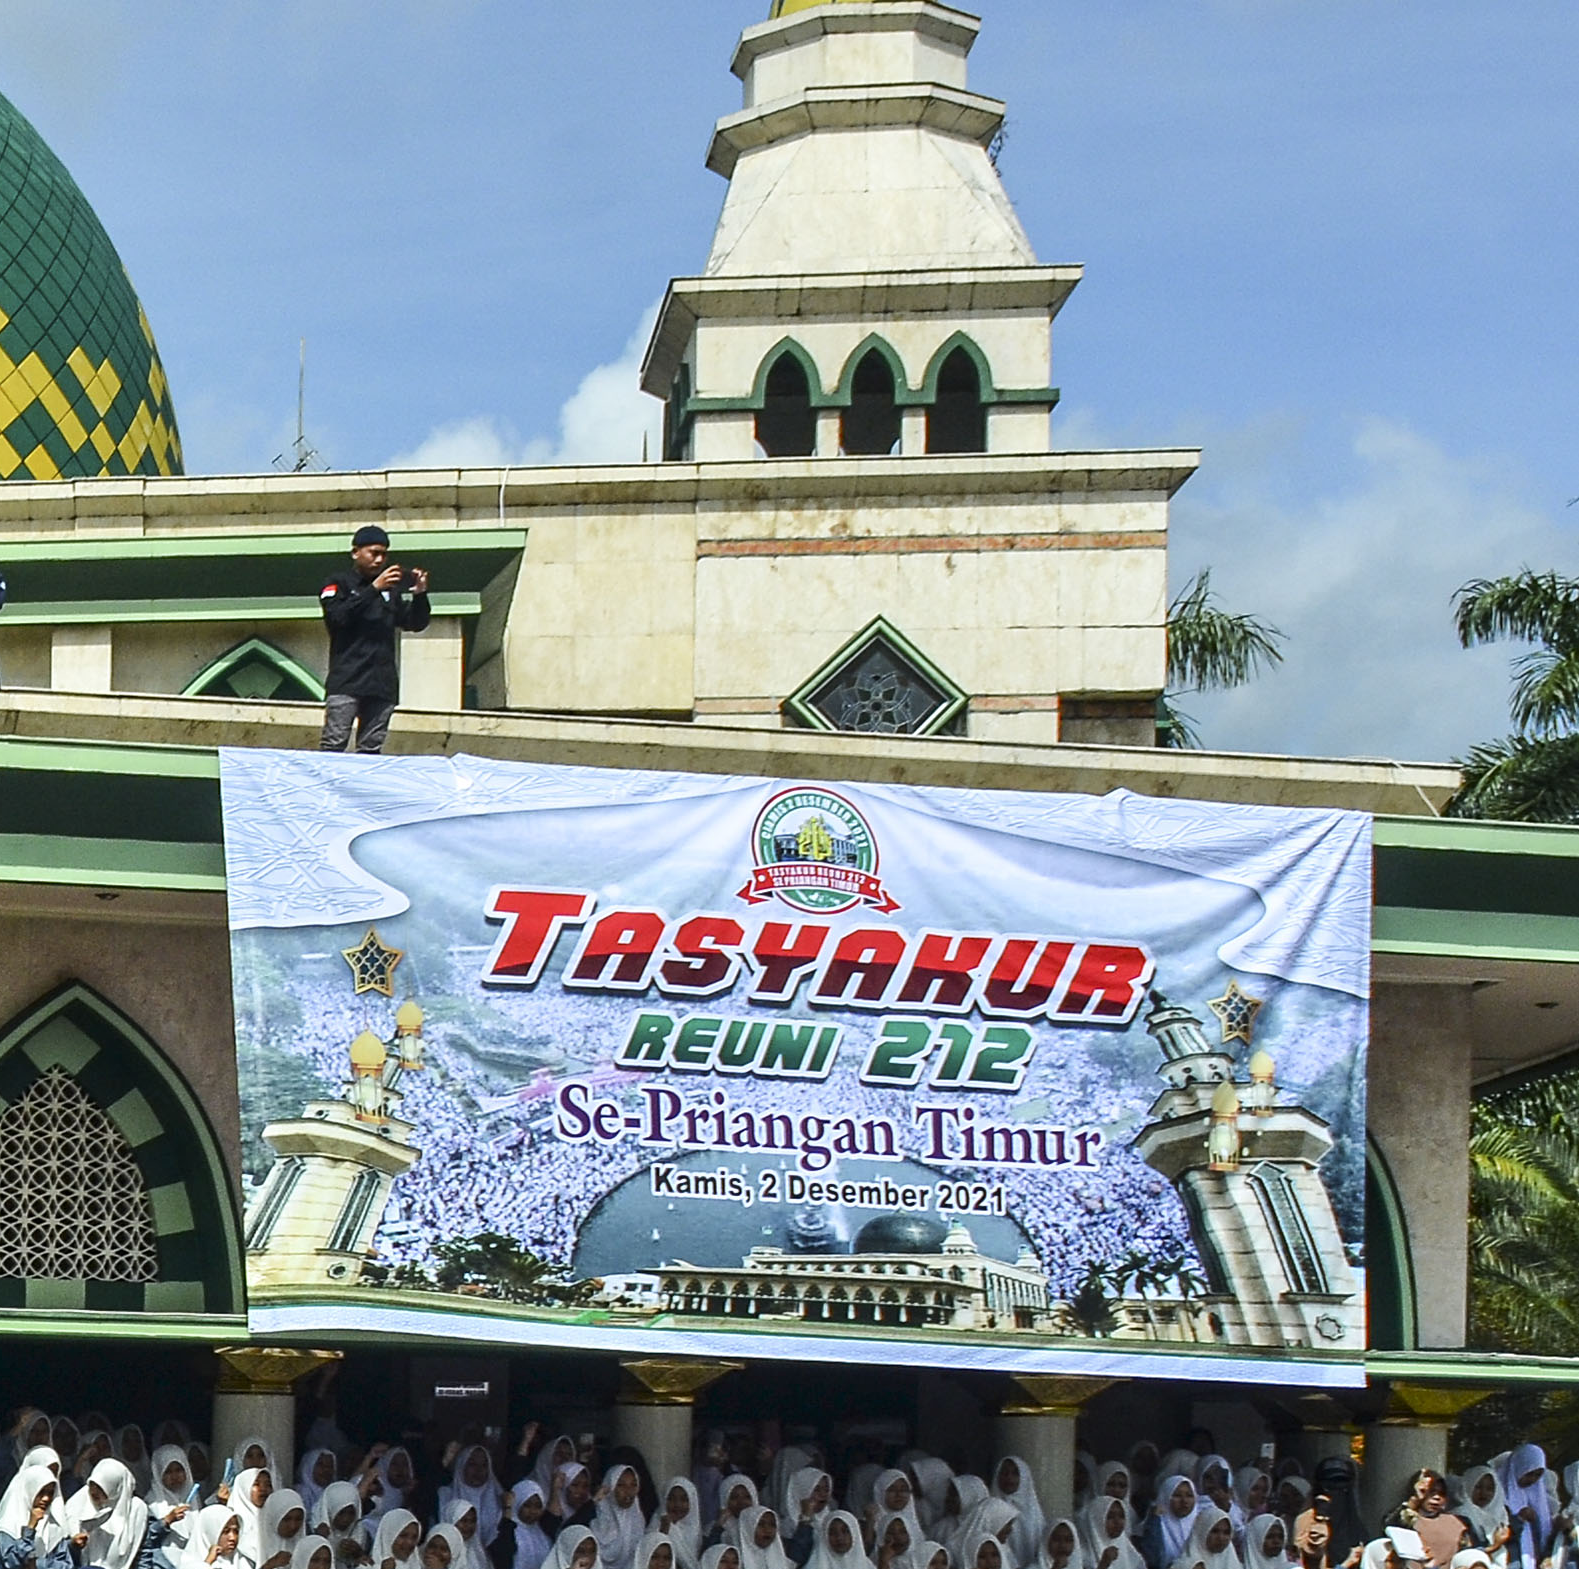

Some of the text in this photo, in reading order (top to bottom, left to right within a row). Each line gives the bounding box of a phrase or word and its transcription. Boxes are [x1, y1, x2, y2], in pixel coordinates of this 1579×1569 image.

[492, 890, 1146, 1017] TASYAKUR
[627, 1017, 1032, 1086] REUNI 212
[557, 1083, 1100, 1170] Se-Priangan Timur
[653, 1164, 1007, 1214] Kamis, 2 Desember 2021
